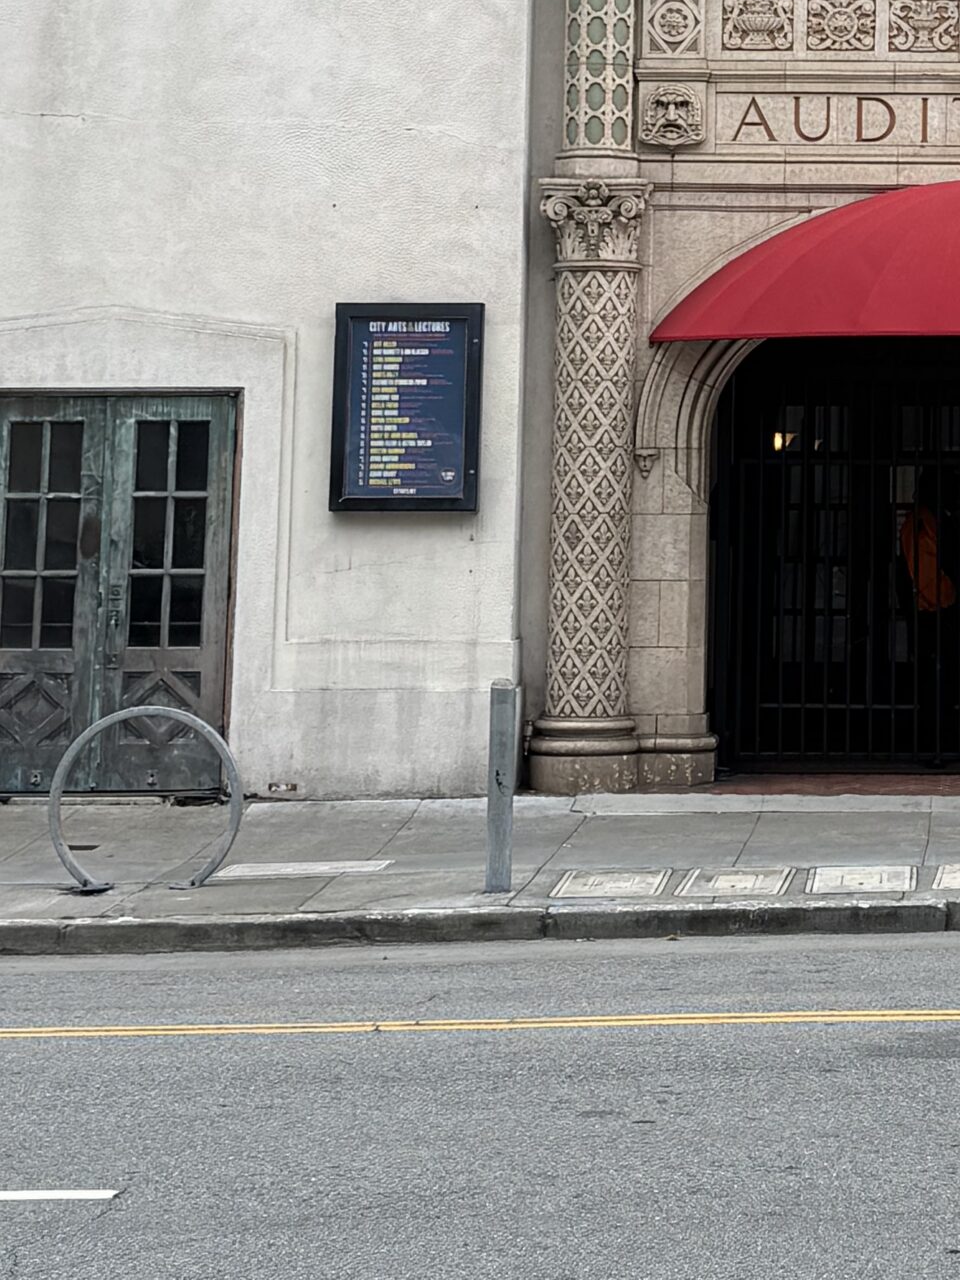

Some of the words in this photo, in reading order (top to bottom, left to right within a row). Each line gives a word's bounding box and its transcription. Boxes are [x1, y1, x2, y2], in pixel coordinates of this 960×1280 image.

[369, 321, 386, 332] CITY
[387, 321, 407, 332] ARTS
[414, 321, 450, 332] LECTURES
